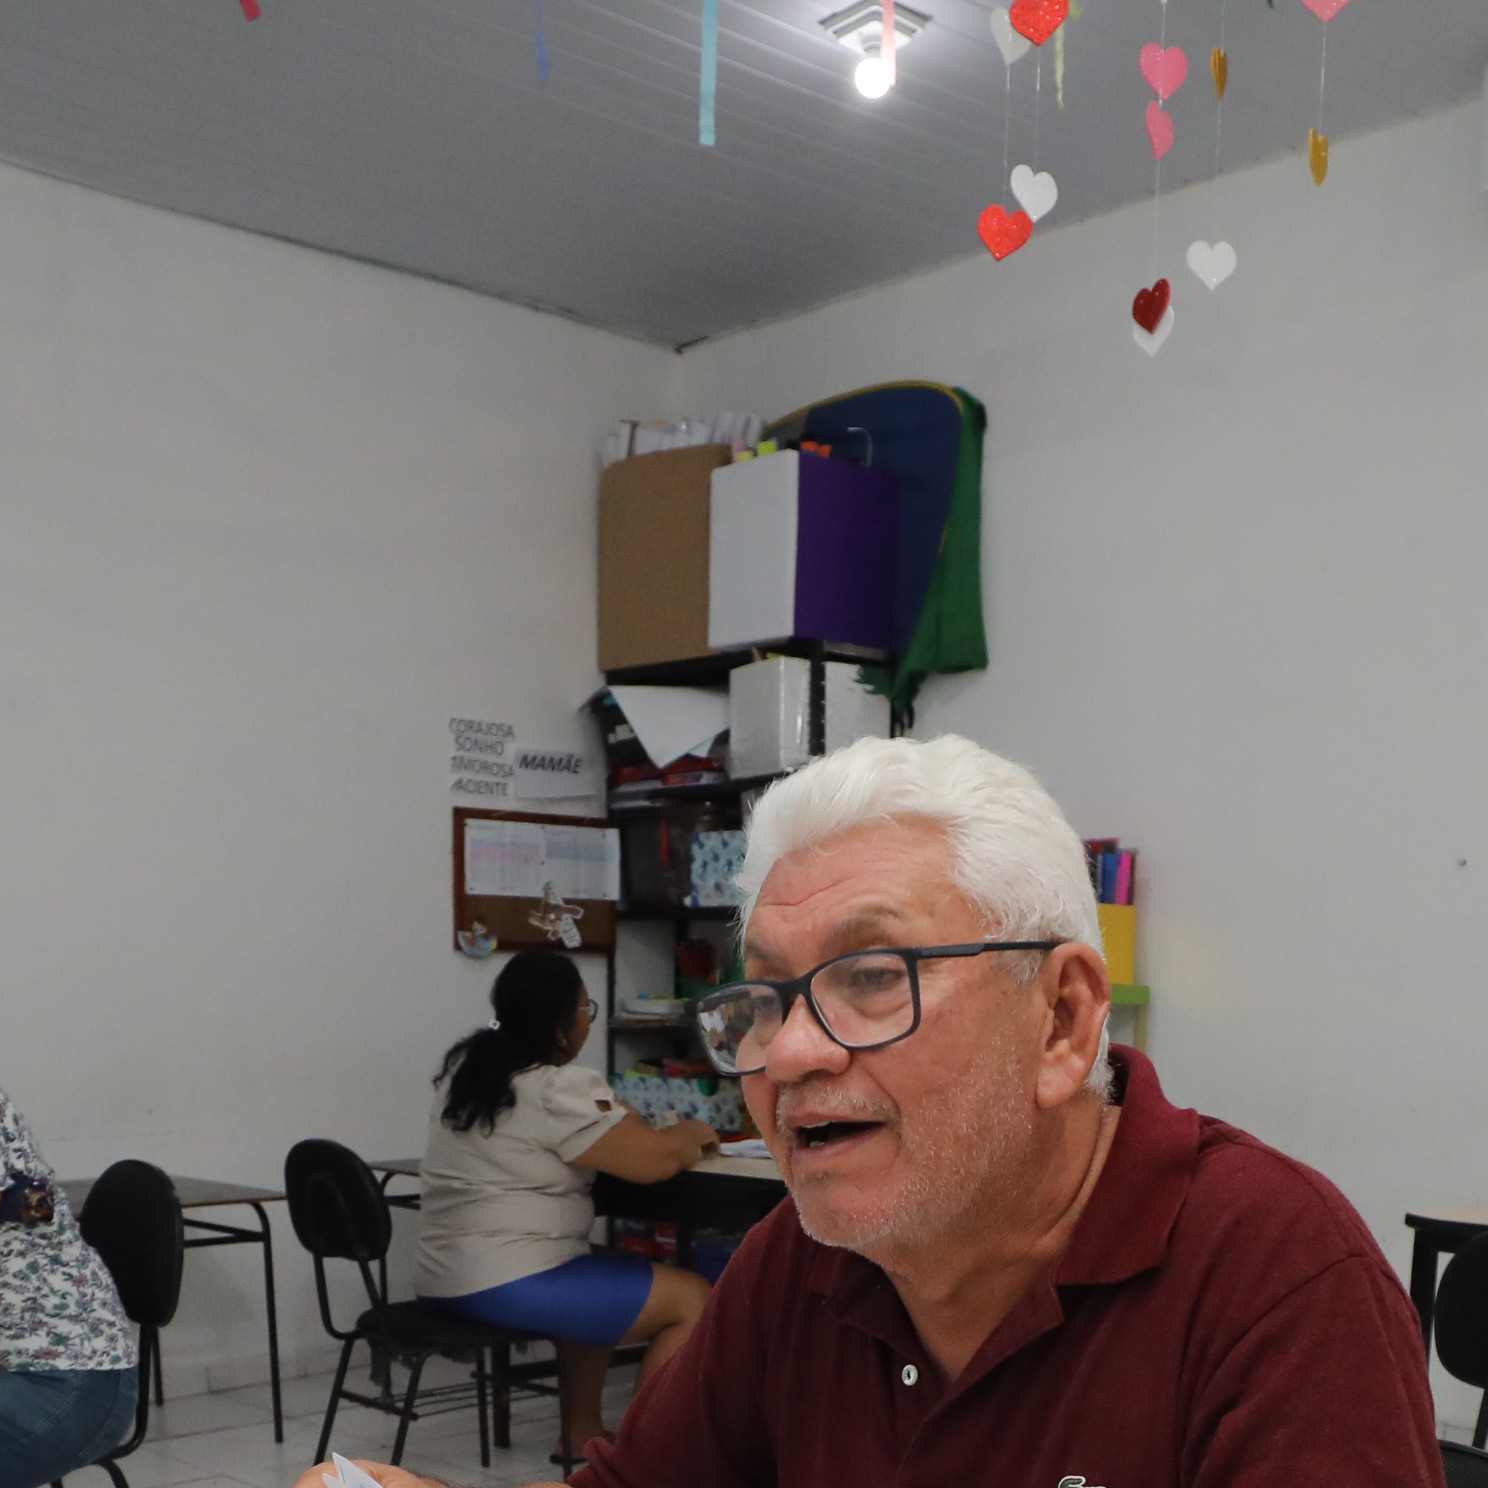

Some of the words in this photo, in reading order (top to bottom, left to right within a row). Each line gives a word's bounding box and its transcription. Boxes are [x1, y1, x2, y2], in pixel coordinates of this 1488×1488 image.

[449, 718, 514, 738] CORAJOSA
[455, 735, 504, 755] SONHO
[519, 753, 583, 774] MAMÃE
